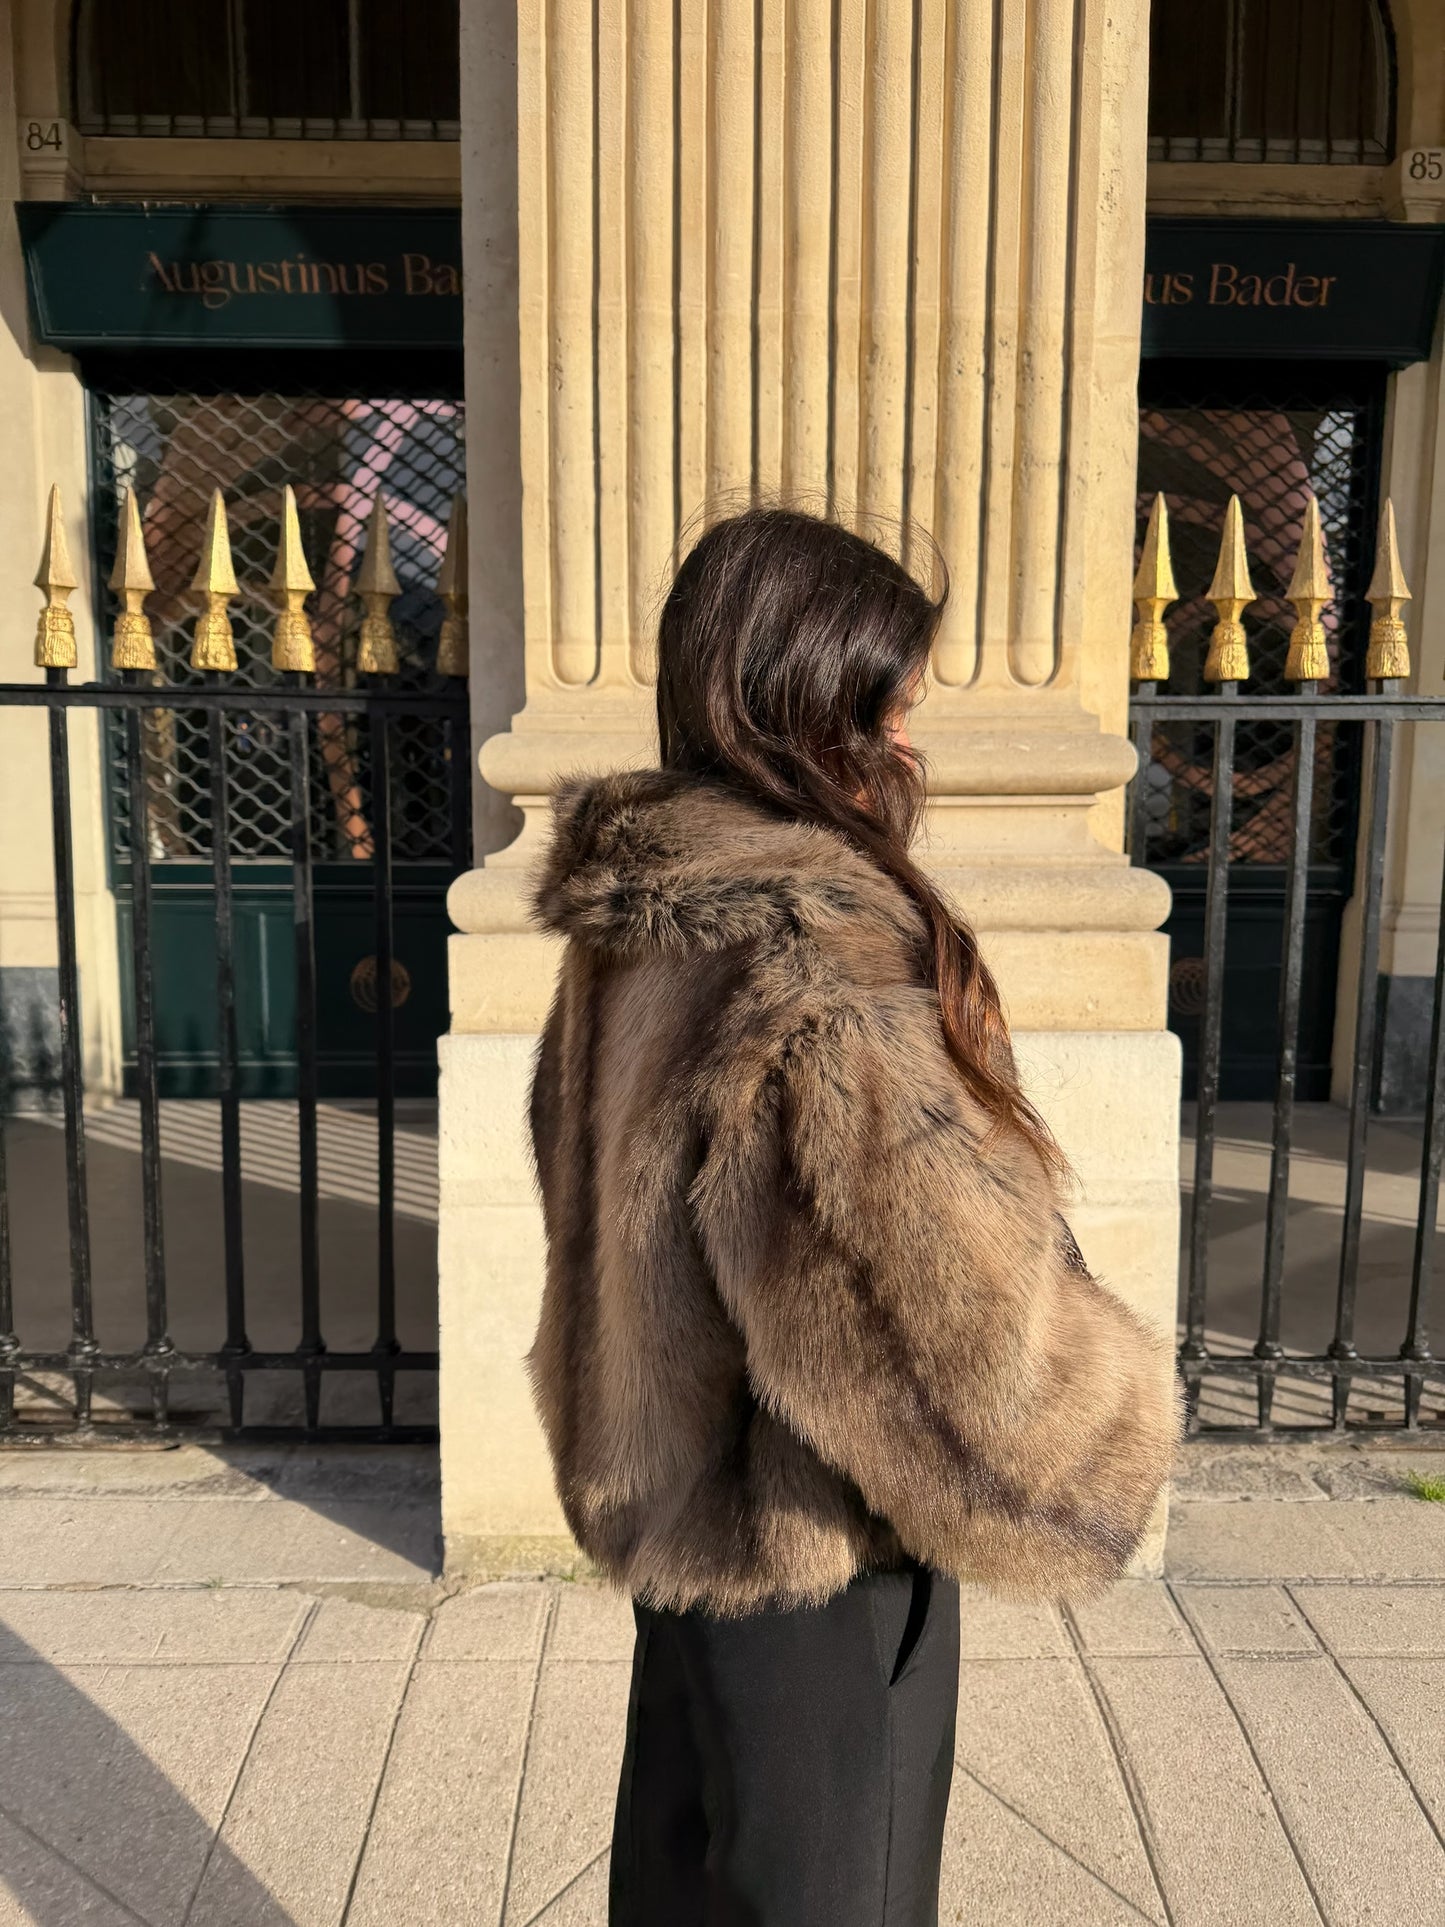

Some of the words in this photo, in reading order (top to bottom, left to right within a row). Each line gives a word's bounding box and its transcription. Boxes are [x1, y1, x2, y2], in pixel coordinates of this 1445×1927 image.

[26, 122, 63, 151] 84
[1409, 151, 1443, 180] 85
[142, 251, 389, 309] Augustinus
[1208, 262, 1336, 307] Bader
